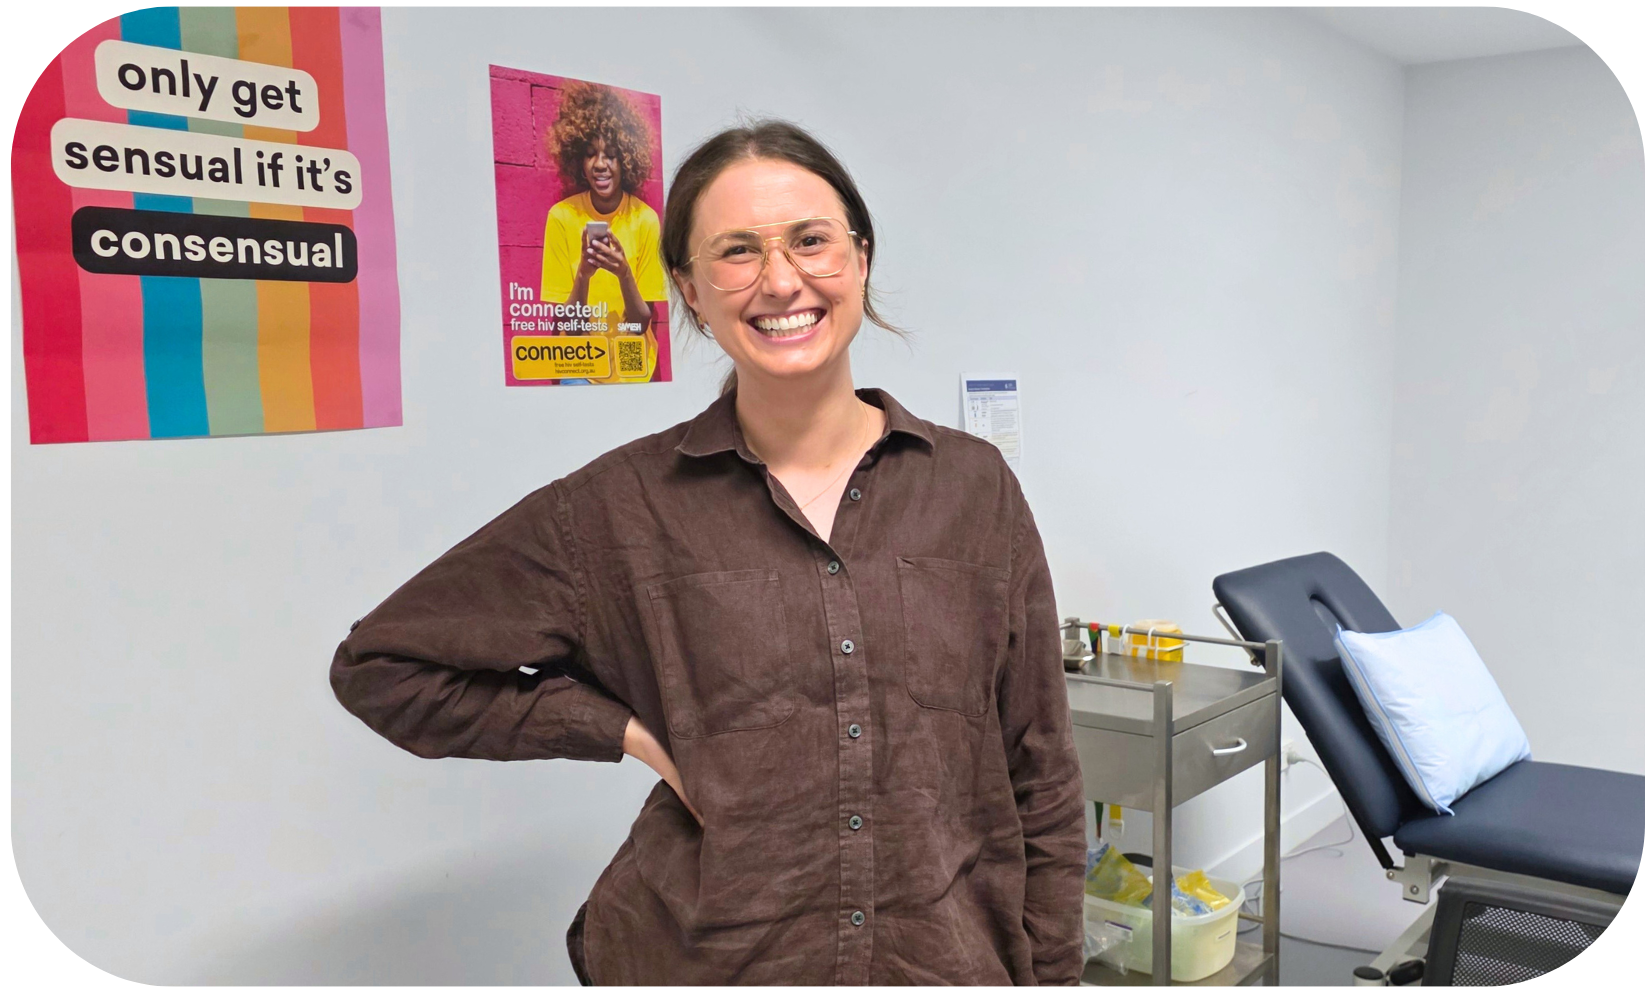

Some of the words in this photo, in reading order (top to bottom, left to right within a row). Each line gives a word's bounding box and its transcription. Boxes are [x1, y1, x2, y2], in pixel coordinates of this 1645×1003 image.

[117, 59, 220, 112] only
[232, 79, 303, 118] get
[64, 140, 243, 185] sensual
[256, 150, 283, 188] if
[295, 154, 352, 195] it's
[91, 228, 344, 268] consensual
[509, 282, 534, 300] I'm
[509, 301, 608, 318] connected!
[511, 319, 535, 331] free
[538, 319, 554, 331] hiv
[557, 319, 608, 332] self-tests
